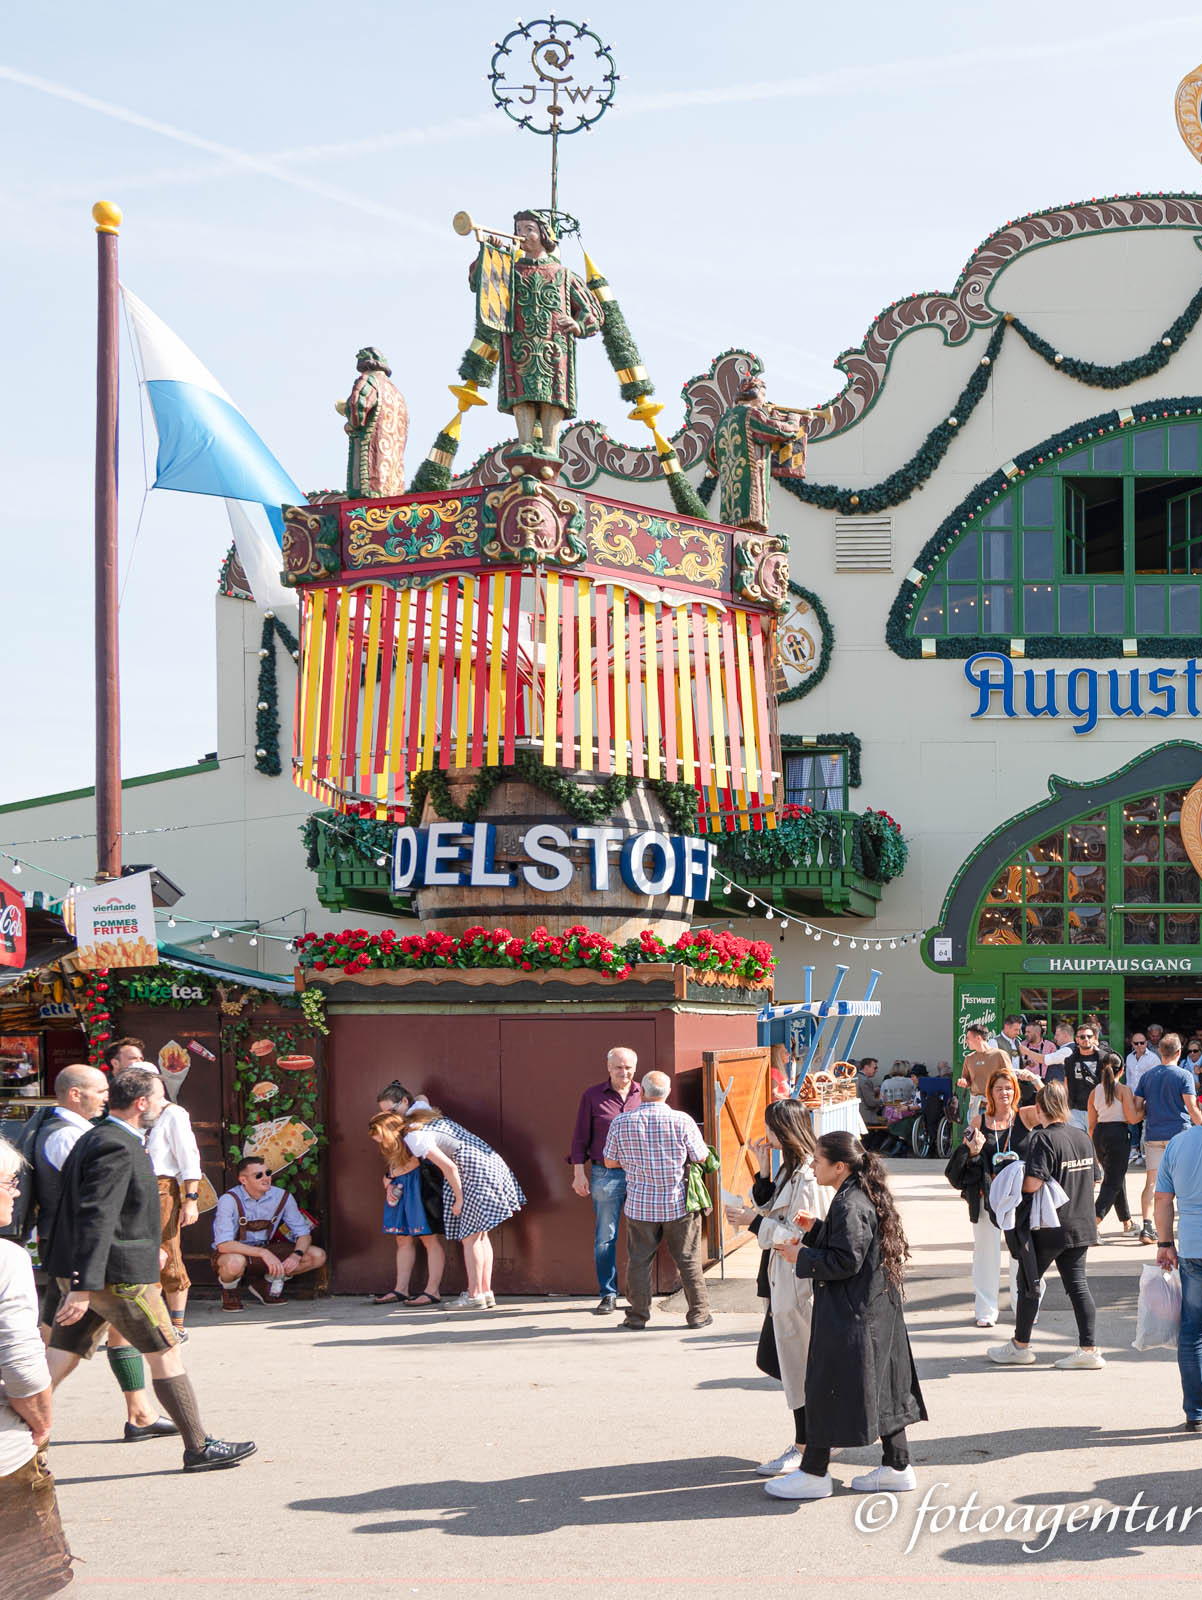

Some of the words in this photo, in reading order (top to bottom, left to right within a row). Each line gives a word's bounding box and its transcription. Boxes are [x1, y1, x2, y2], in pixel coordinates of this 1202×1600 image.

[564, 85, 593, 104] W
[93, 903, 137, 912] vierlande
[93, 918, 138, 928] POMMES
[94, 925, 139, 936] FRITES
[1050, 958, 1192, 972] HAUPTAUSGANG
[40, 1002, 71, 1018] etit
